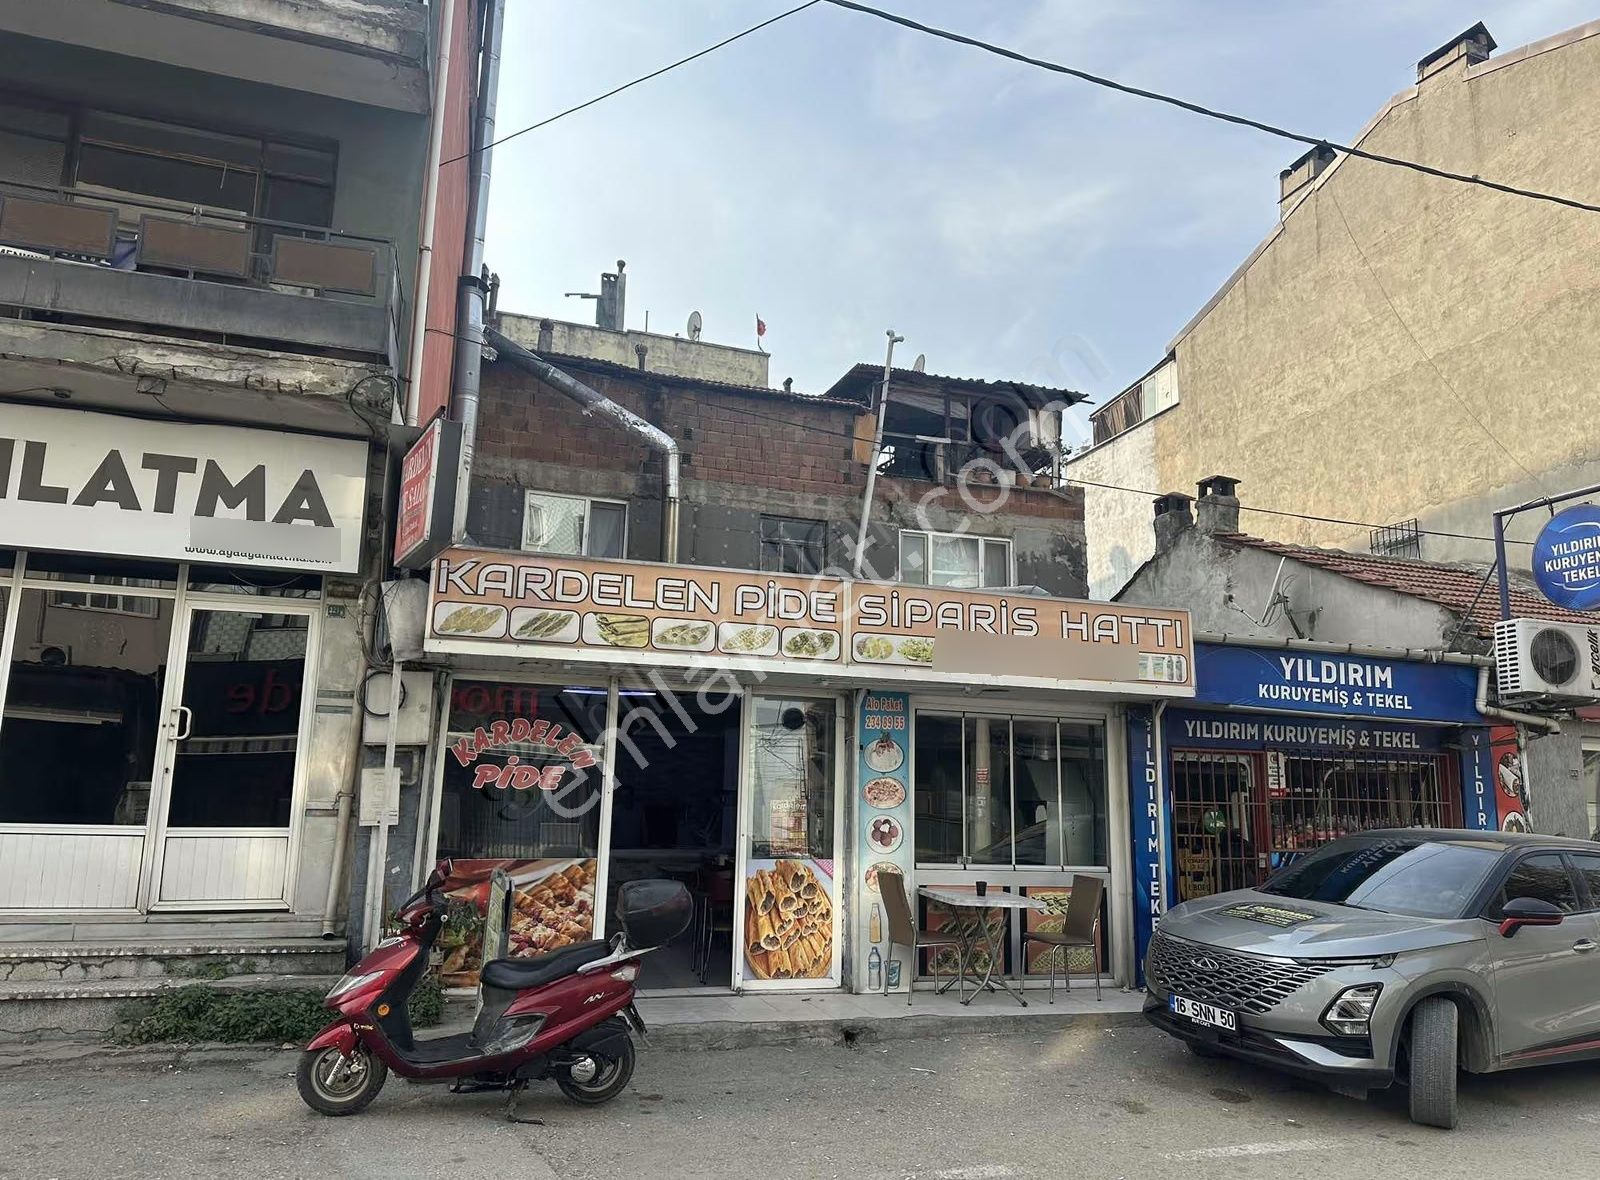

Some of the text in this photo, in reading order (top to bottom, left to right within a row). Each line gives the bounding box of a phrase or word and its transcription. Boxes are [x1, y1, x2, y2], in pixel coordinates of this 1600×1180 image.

[437, 558, 838, 624] KARDELEN PİDE
[1061, 611, 1184, 649] HATTI
[1279, 656, 1392, 689] YILDIRIM
[865, 696, 903, 712] Alo Paket
[1258, 683, 1413, 710] KURUYEMİŞ & TEKEL
[865, 714, 881, 730] 234
[881, 715, 893, 730] 89
[1185, 720, 1420, 750] YILDIRIM KURUYEMİŞ & TEKEL
[450, 718, 596, 769] KARDELEN
[472, 755, 566, 790] PİDE
[1472, 735, 1487, 831] YILDIR
[1175, 997, 1235, 1028] 16 SNN 50
